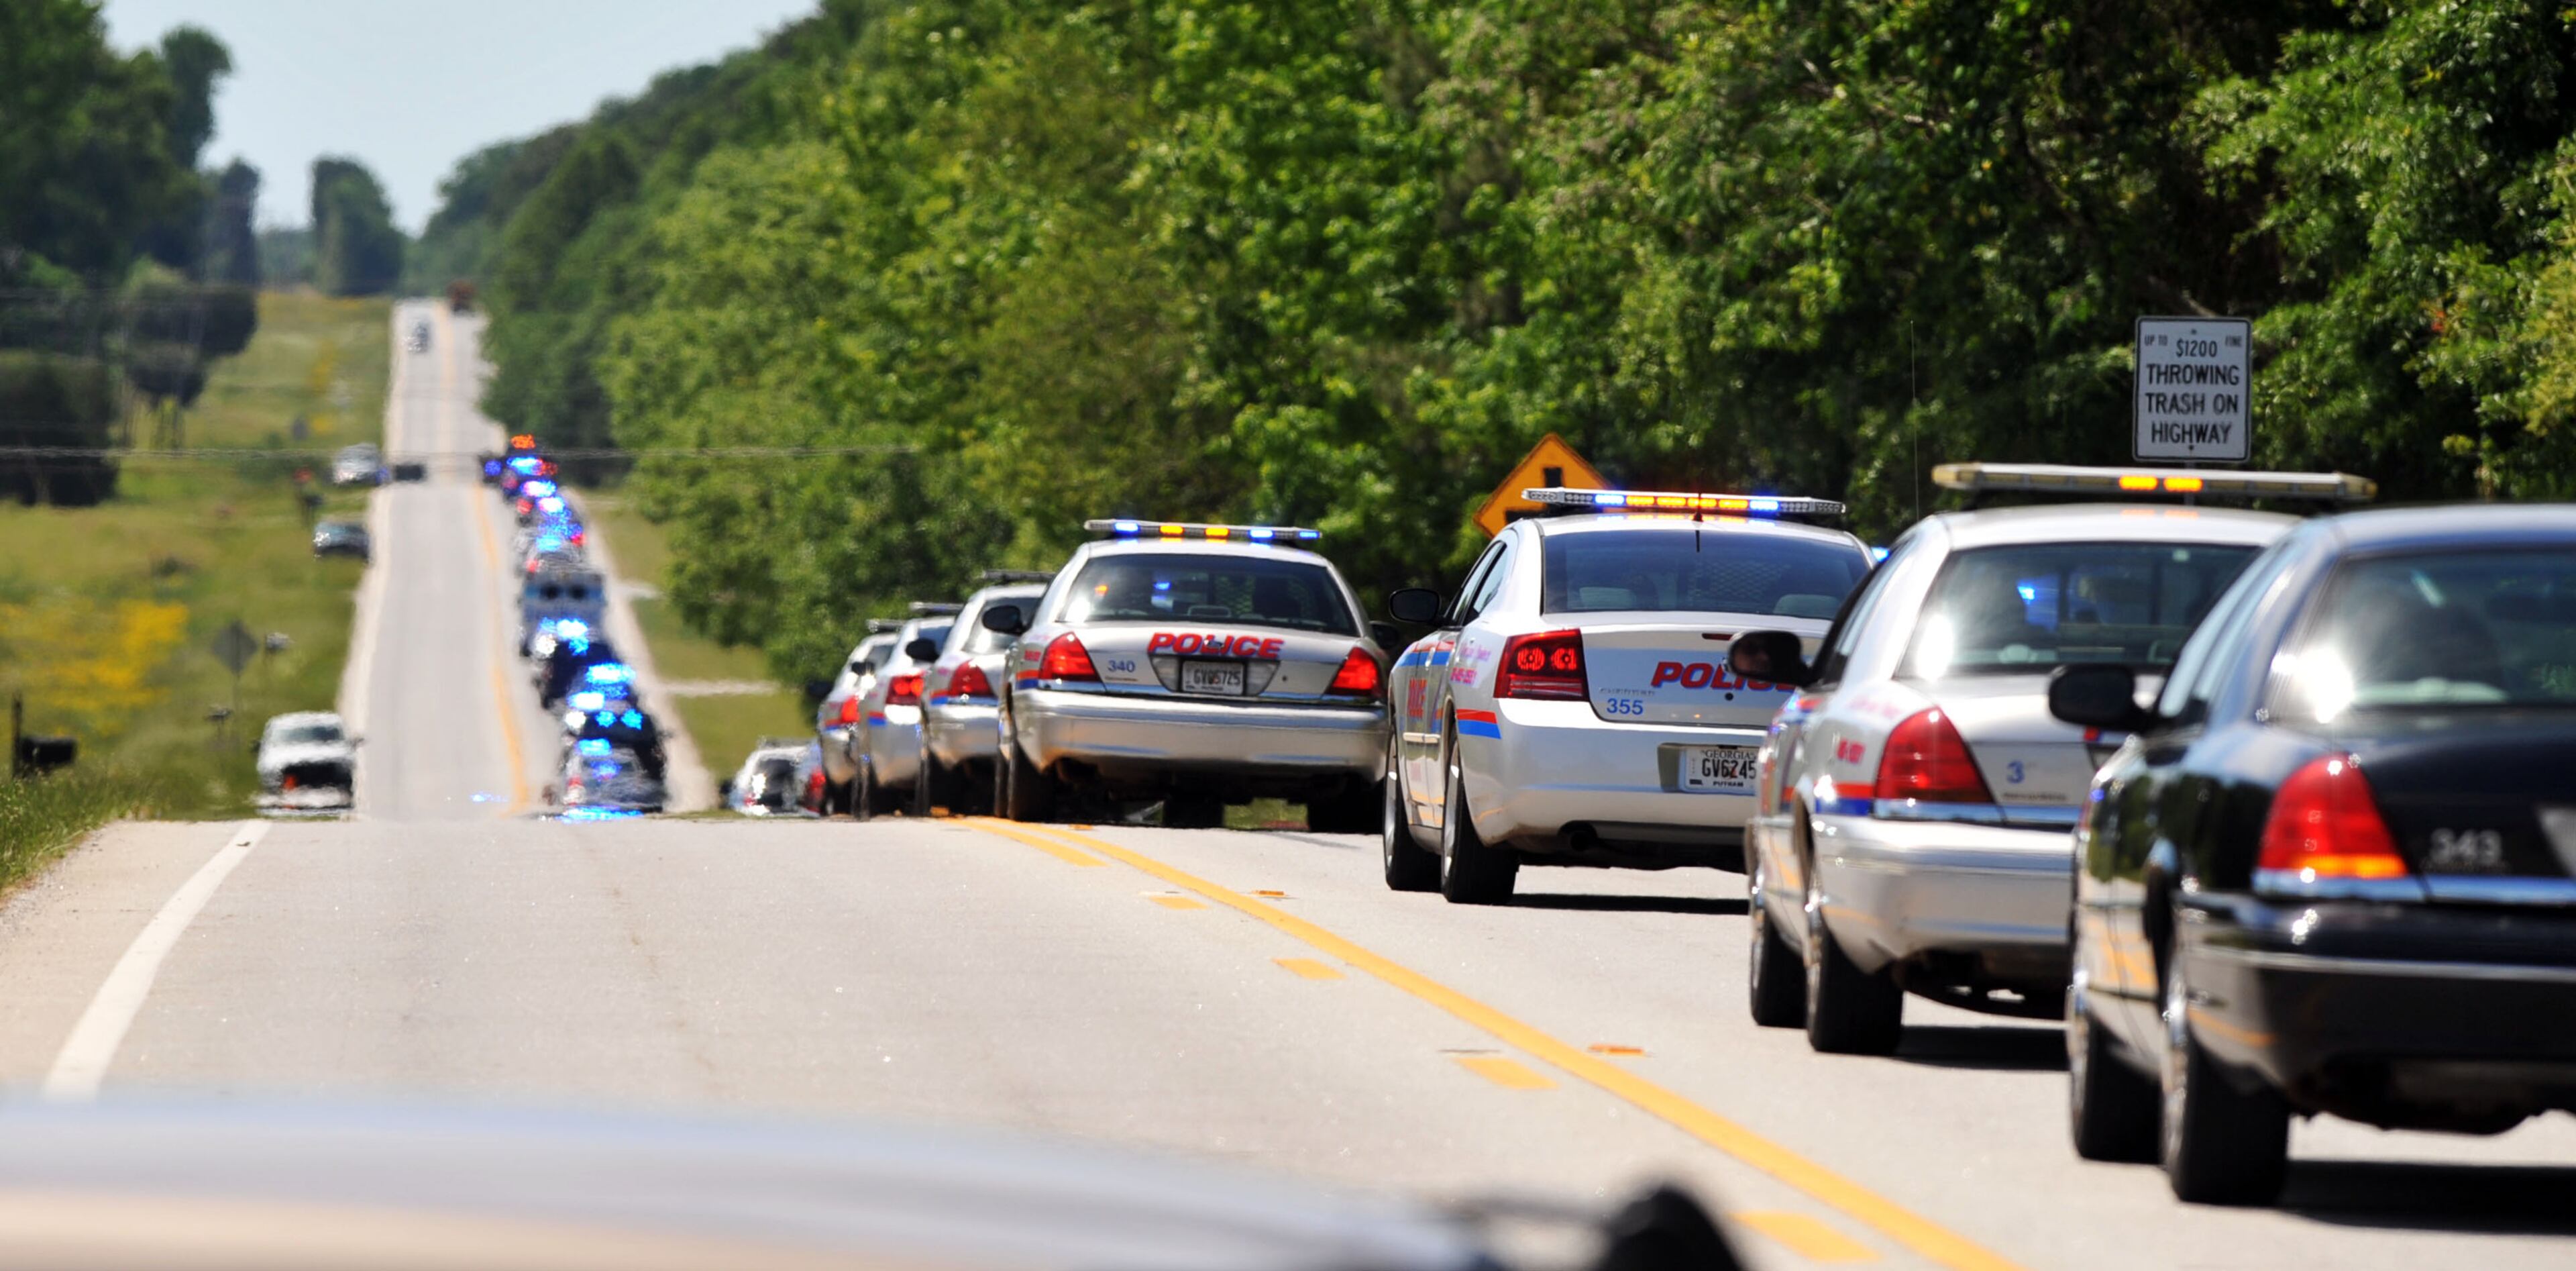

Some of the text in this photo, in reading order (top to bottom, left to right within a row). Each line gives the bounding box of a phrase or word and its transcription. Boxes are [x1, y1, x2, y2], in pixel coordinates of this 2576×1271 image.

[2176, 338, 2218, 358] $1200
[2147, 364, 2239, 386] THROWING
[2145, 393, 2205, 415] TRASH
[2213, 393, 2239, 415] ON
[2151, 421, 2232, 444] HIGHWAY
[1148, 632, 1285, 658] POLICE
[1108, 660, 1135, 672] 340
[1650, 661, 1796, 692] POLI
[1607, 698, 1643, 715] 355
[1705, 749, 1752, 760] GEORGIA
[2006, 760, 2025, 784] 3
[2430, 827, 2502, 864] 343
